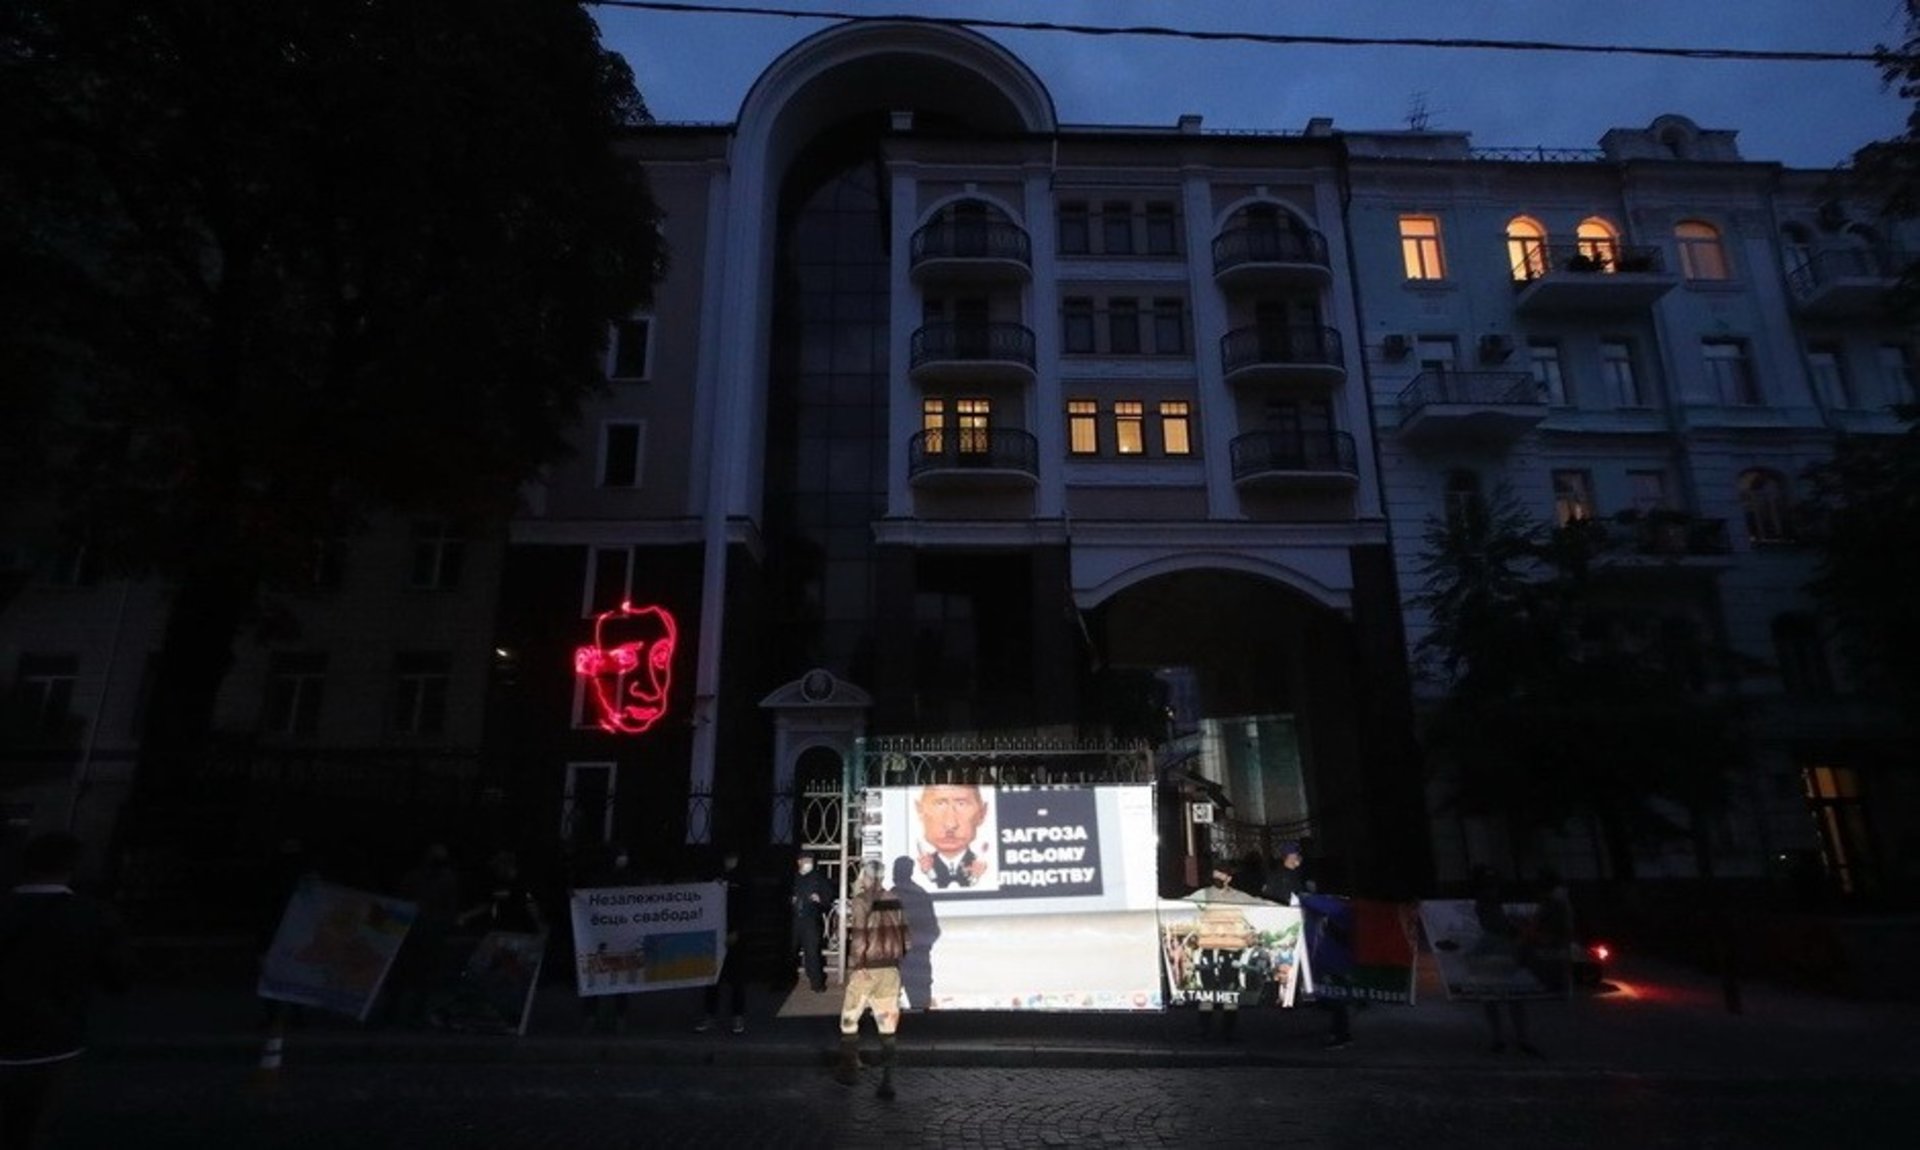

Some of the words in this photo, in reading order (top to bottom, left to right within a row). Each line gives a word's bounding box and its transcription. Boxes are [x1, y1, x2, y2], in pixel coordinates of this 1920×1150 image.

[1001, 826, 1088, 843] ЗАГРОЗА
[1005, 846, 1086, 865] ВСЬОМУ
[999, 866, 1095, 887] ЛЮДСТВУ
[589, 891, 702, 906] Незалежнасць
[633, 908, 704, 923] свабода!
[1187, 989, 1214, 1003] ТАМ
[1215, 990, 1240, 1005] НЕТ
